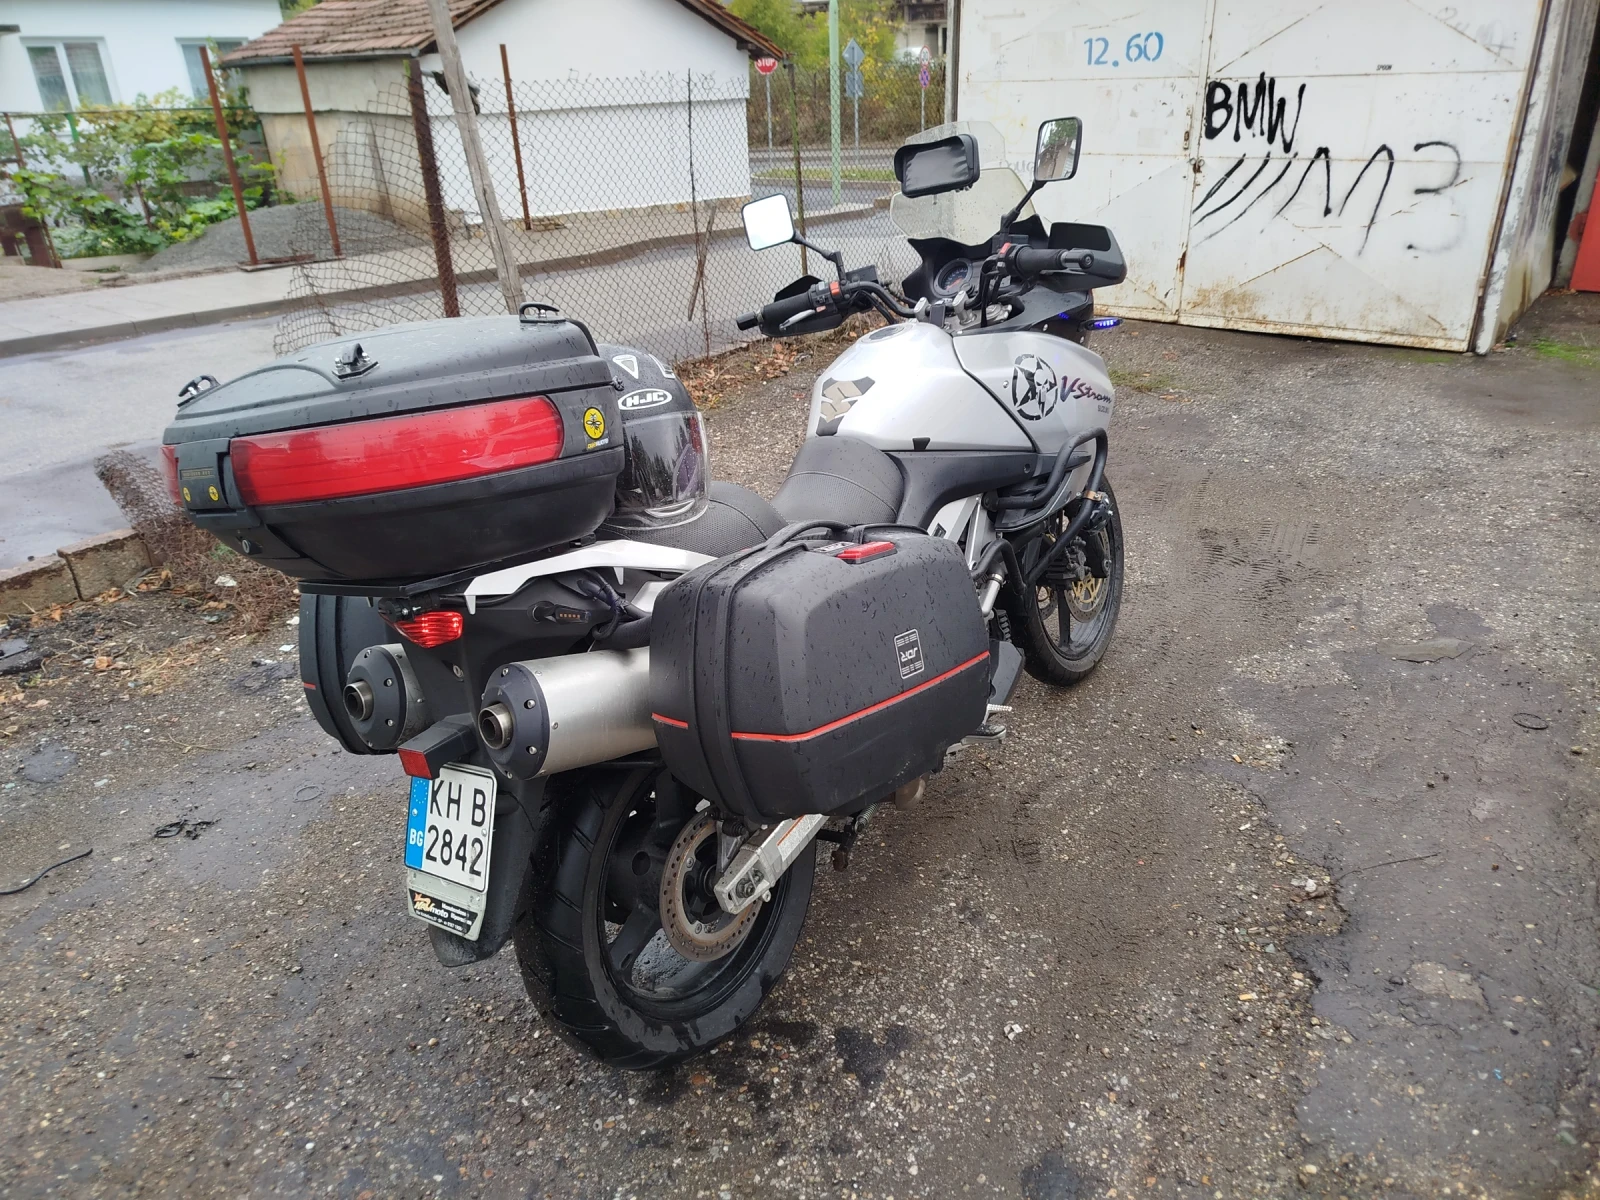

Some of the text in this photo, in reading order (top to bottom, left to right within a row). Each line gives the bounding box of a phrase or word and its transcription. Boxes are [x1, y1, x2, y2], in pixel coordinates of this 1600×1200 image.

[757, 57, 776, 67] STOP
[1205, 72, 1306, 154] BMW
[625, 391, 665, 408] HJC
[430, 779, 487, 827] KH B
[409, 828, 423, 847] BG
[425, 824, 484, 877] 2842
